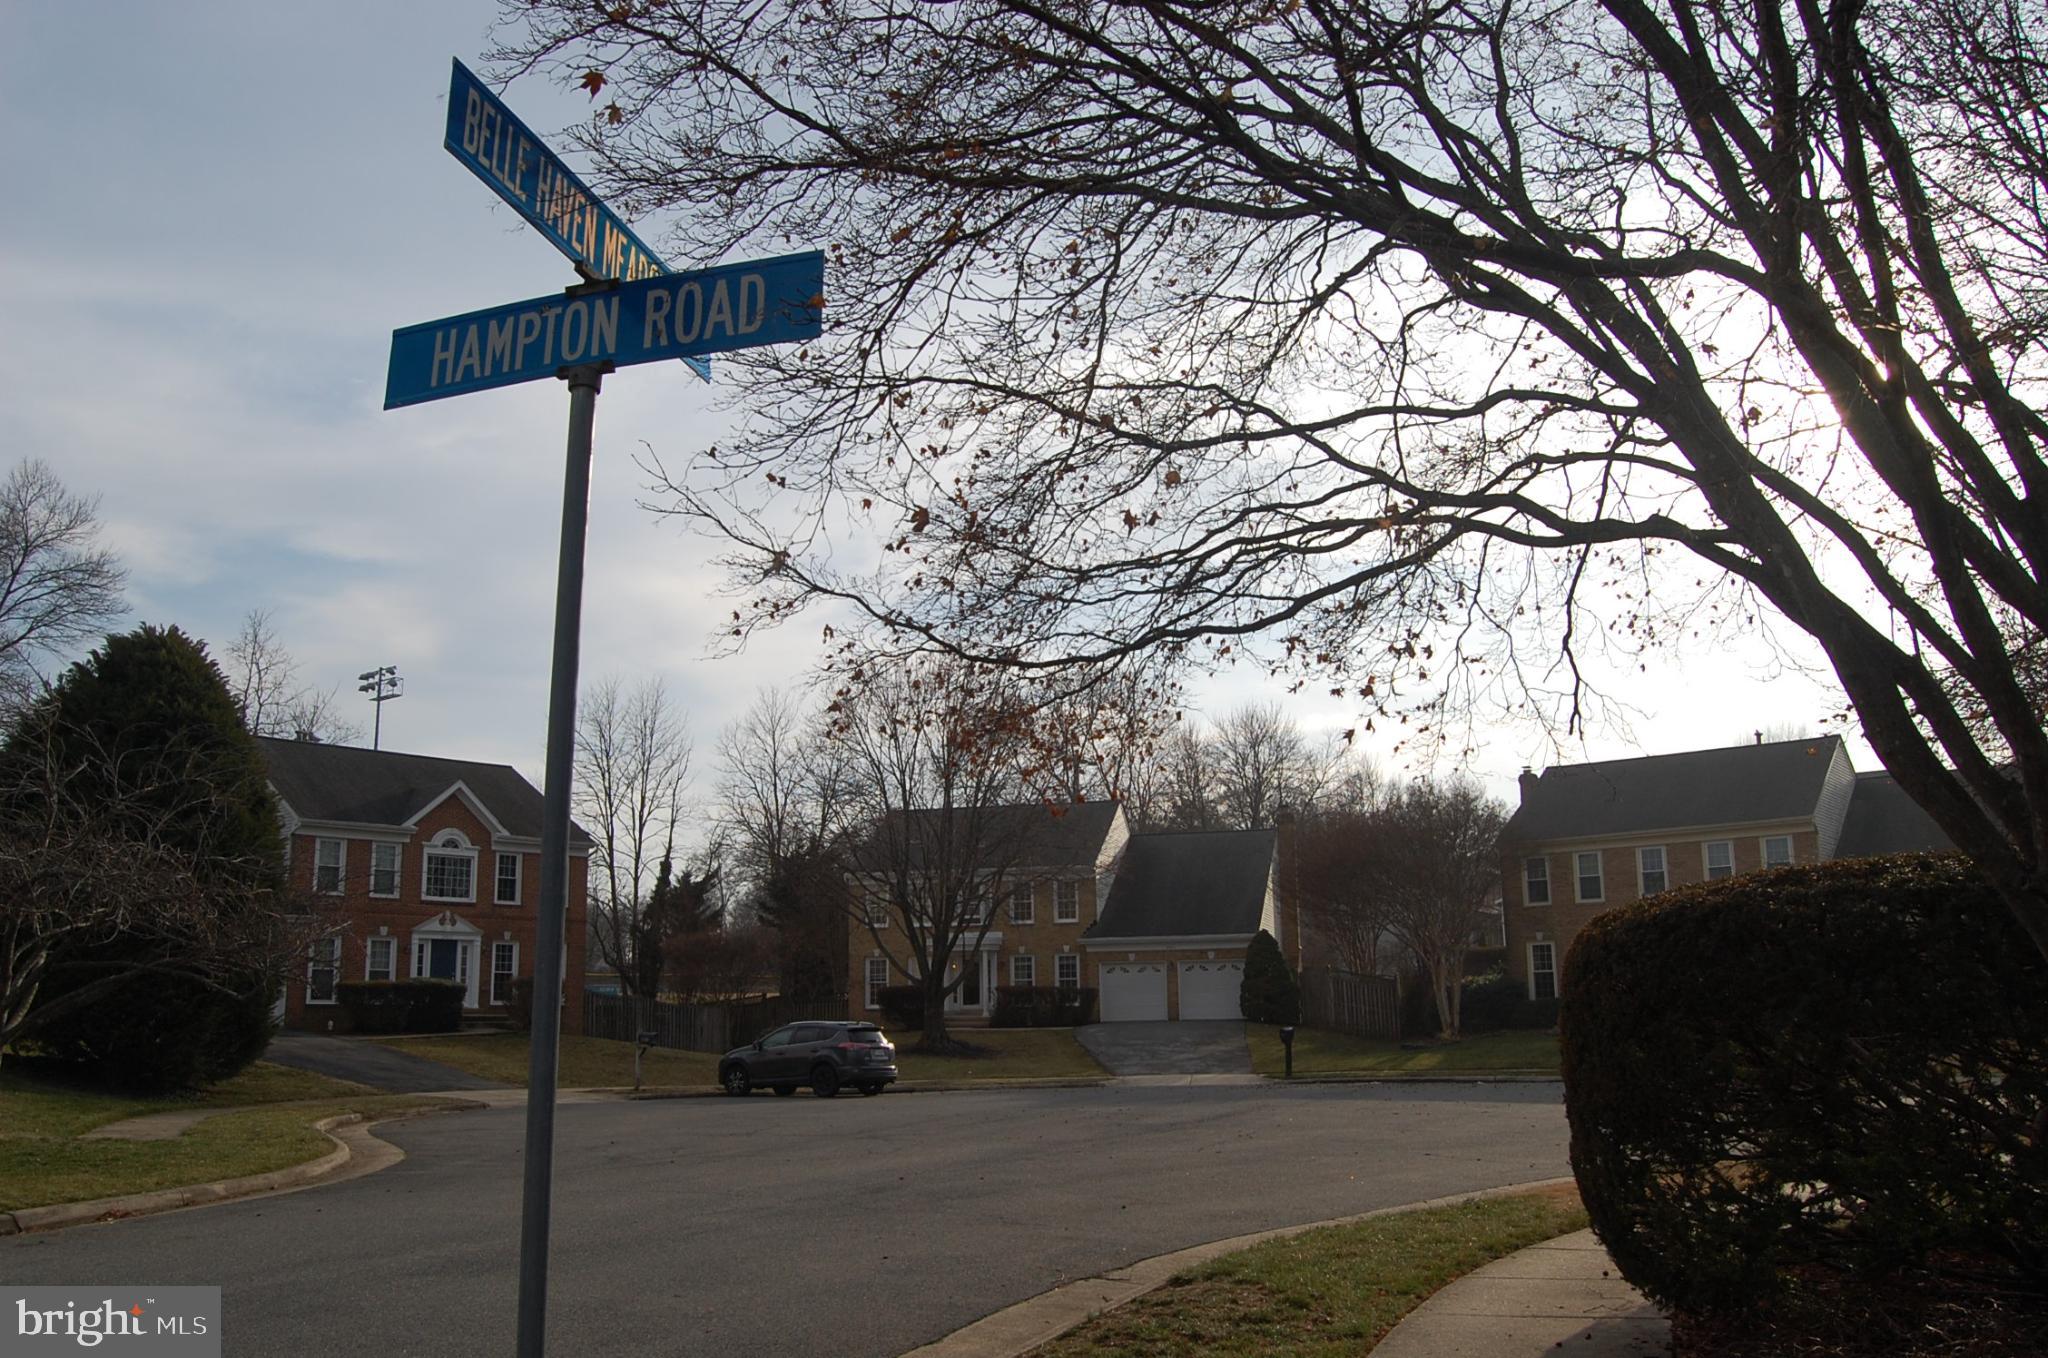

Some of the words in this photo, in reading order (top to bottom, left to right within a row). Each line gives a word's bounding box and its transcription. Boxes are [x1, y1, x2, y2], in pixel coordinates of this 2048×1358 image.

[463, 86, 531, 203] BELLE
[536, 155, 598, 264] HAVEN
[602, 219, 660, 281] MEA
[430, 296, 619, 387] HAMPTON
[643, 273, 766, 350] ROAD
